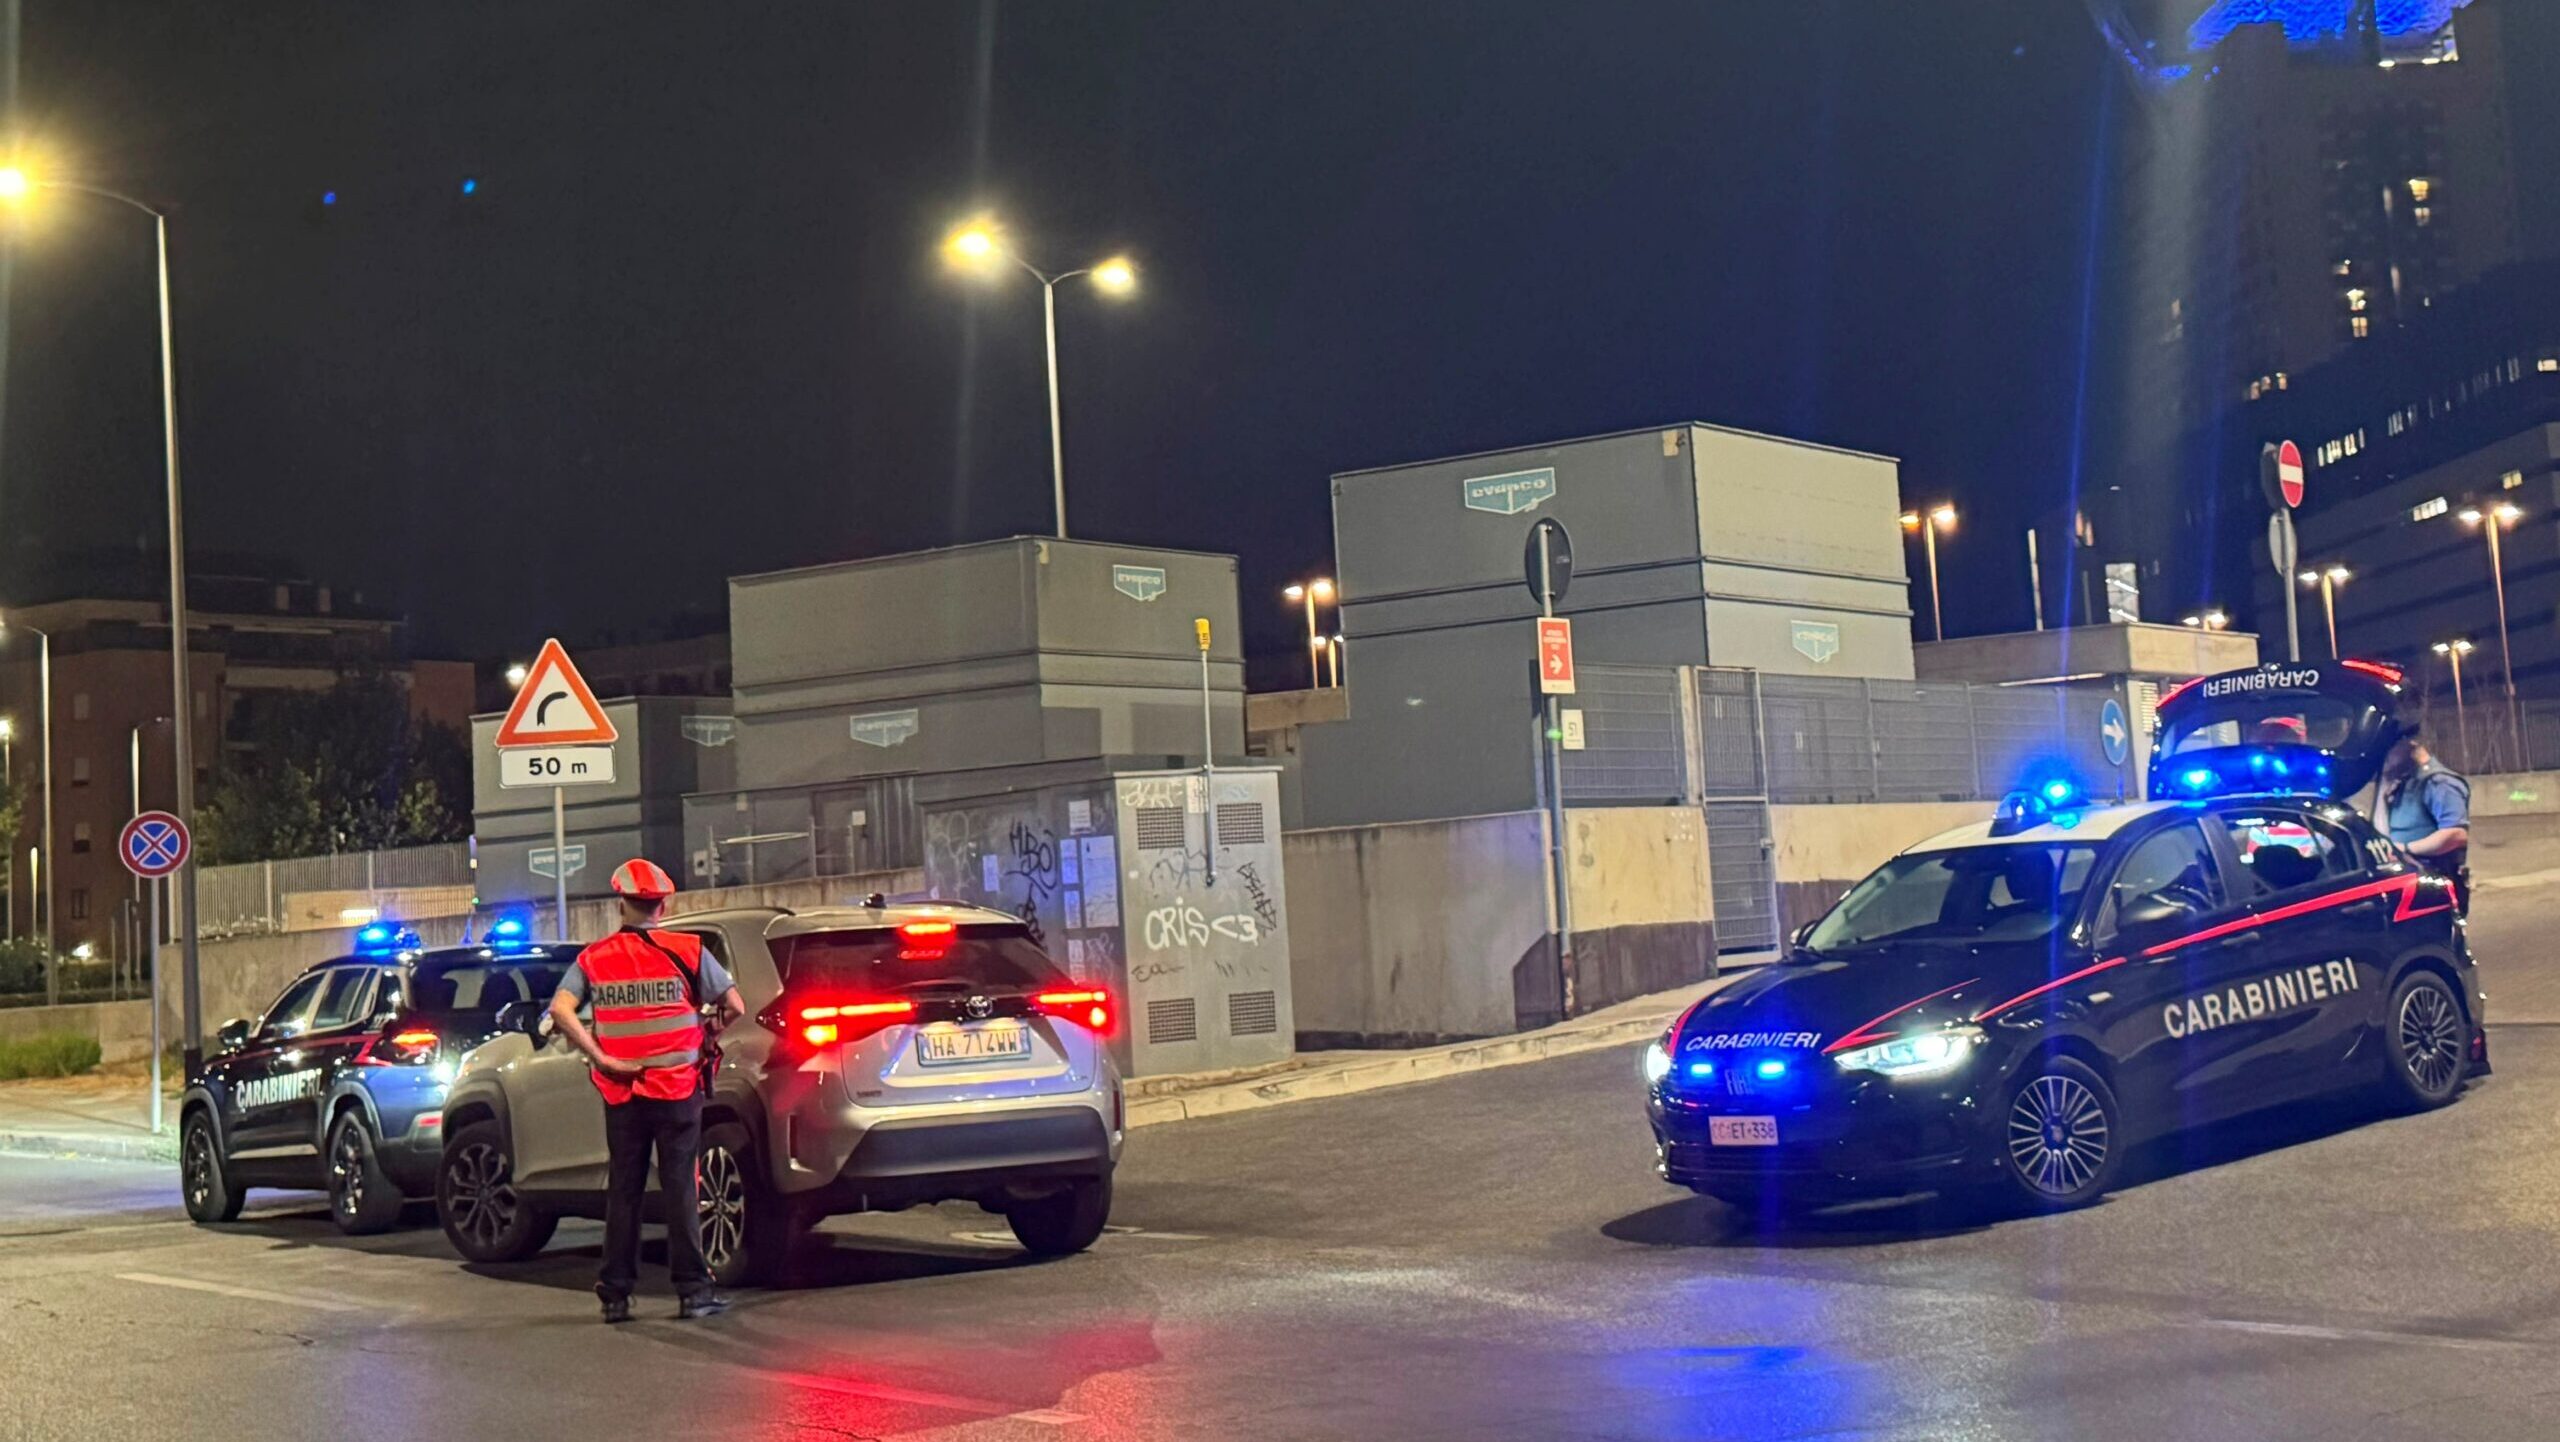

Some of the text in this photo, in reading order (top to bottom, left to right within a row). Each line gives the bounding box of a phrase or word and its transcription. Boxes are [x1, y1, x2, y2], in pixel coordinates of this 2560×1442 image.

[2203, 668, 2319, 698] CARABINIERI
[529, 757, 587, 775] 50 m
[2164, 957, 2359, 1039] CARABINIERI
[1685, 1031, 1822, 1052] CARABINIERI
[235, 1067, 323, 1108] CARABINIERI
